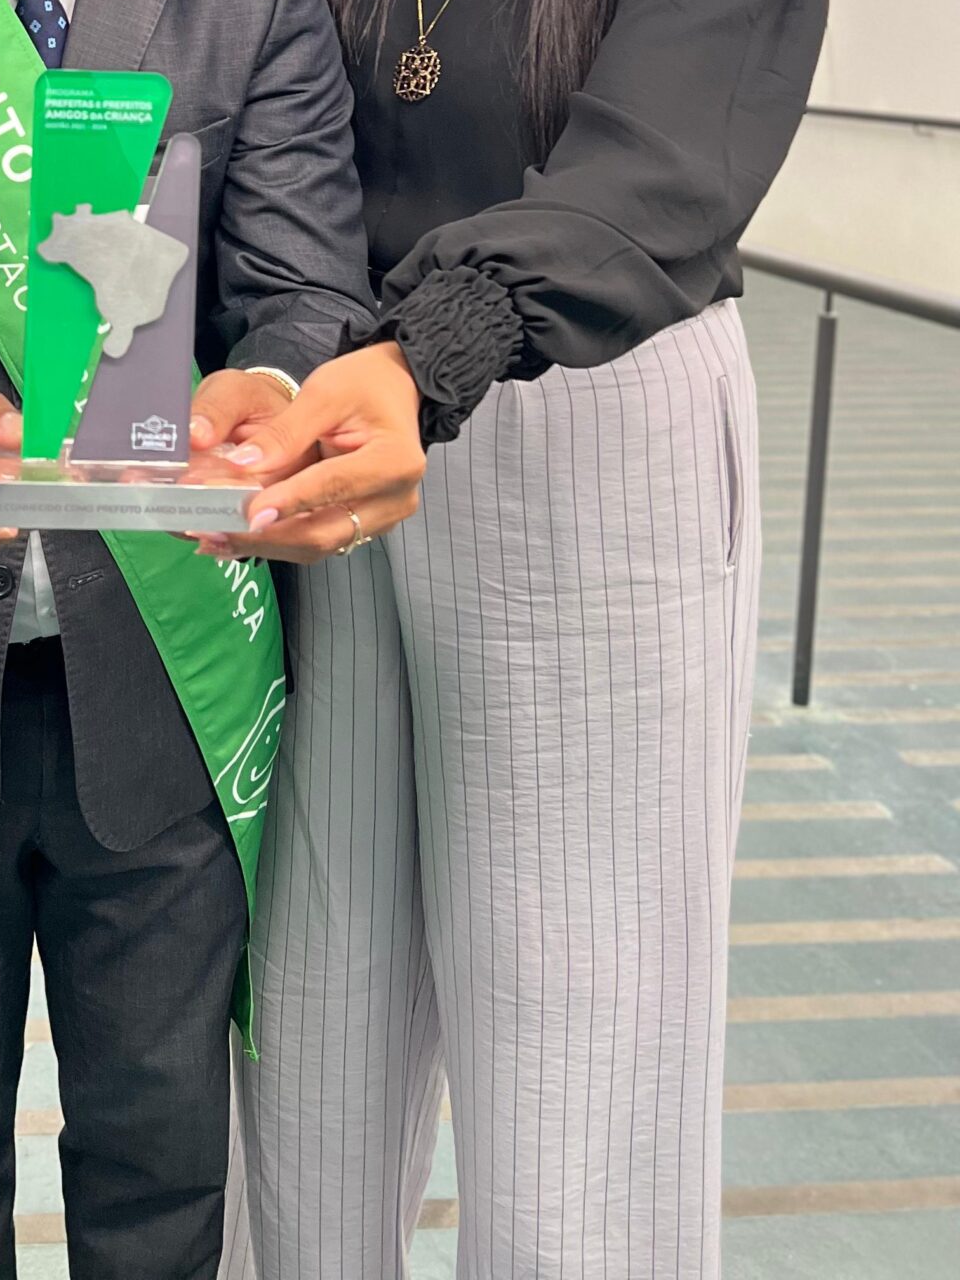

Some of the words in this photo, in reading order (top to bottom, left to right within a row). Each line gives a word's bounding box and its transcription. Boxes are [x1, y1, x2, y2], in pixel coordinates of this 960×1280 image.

[45, 110, 88, 120] AMIGOS
[104, 111, 153, 124] CRIANÇA
[96, 504, 141, 514] PREFEITO
[144, 505, 177, 515] AMIGO
